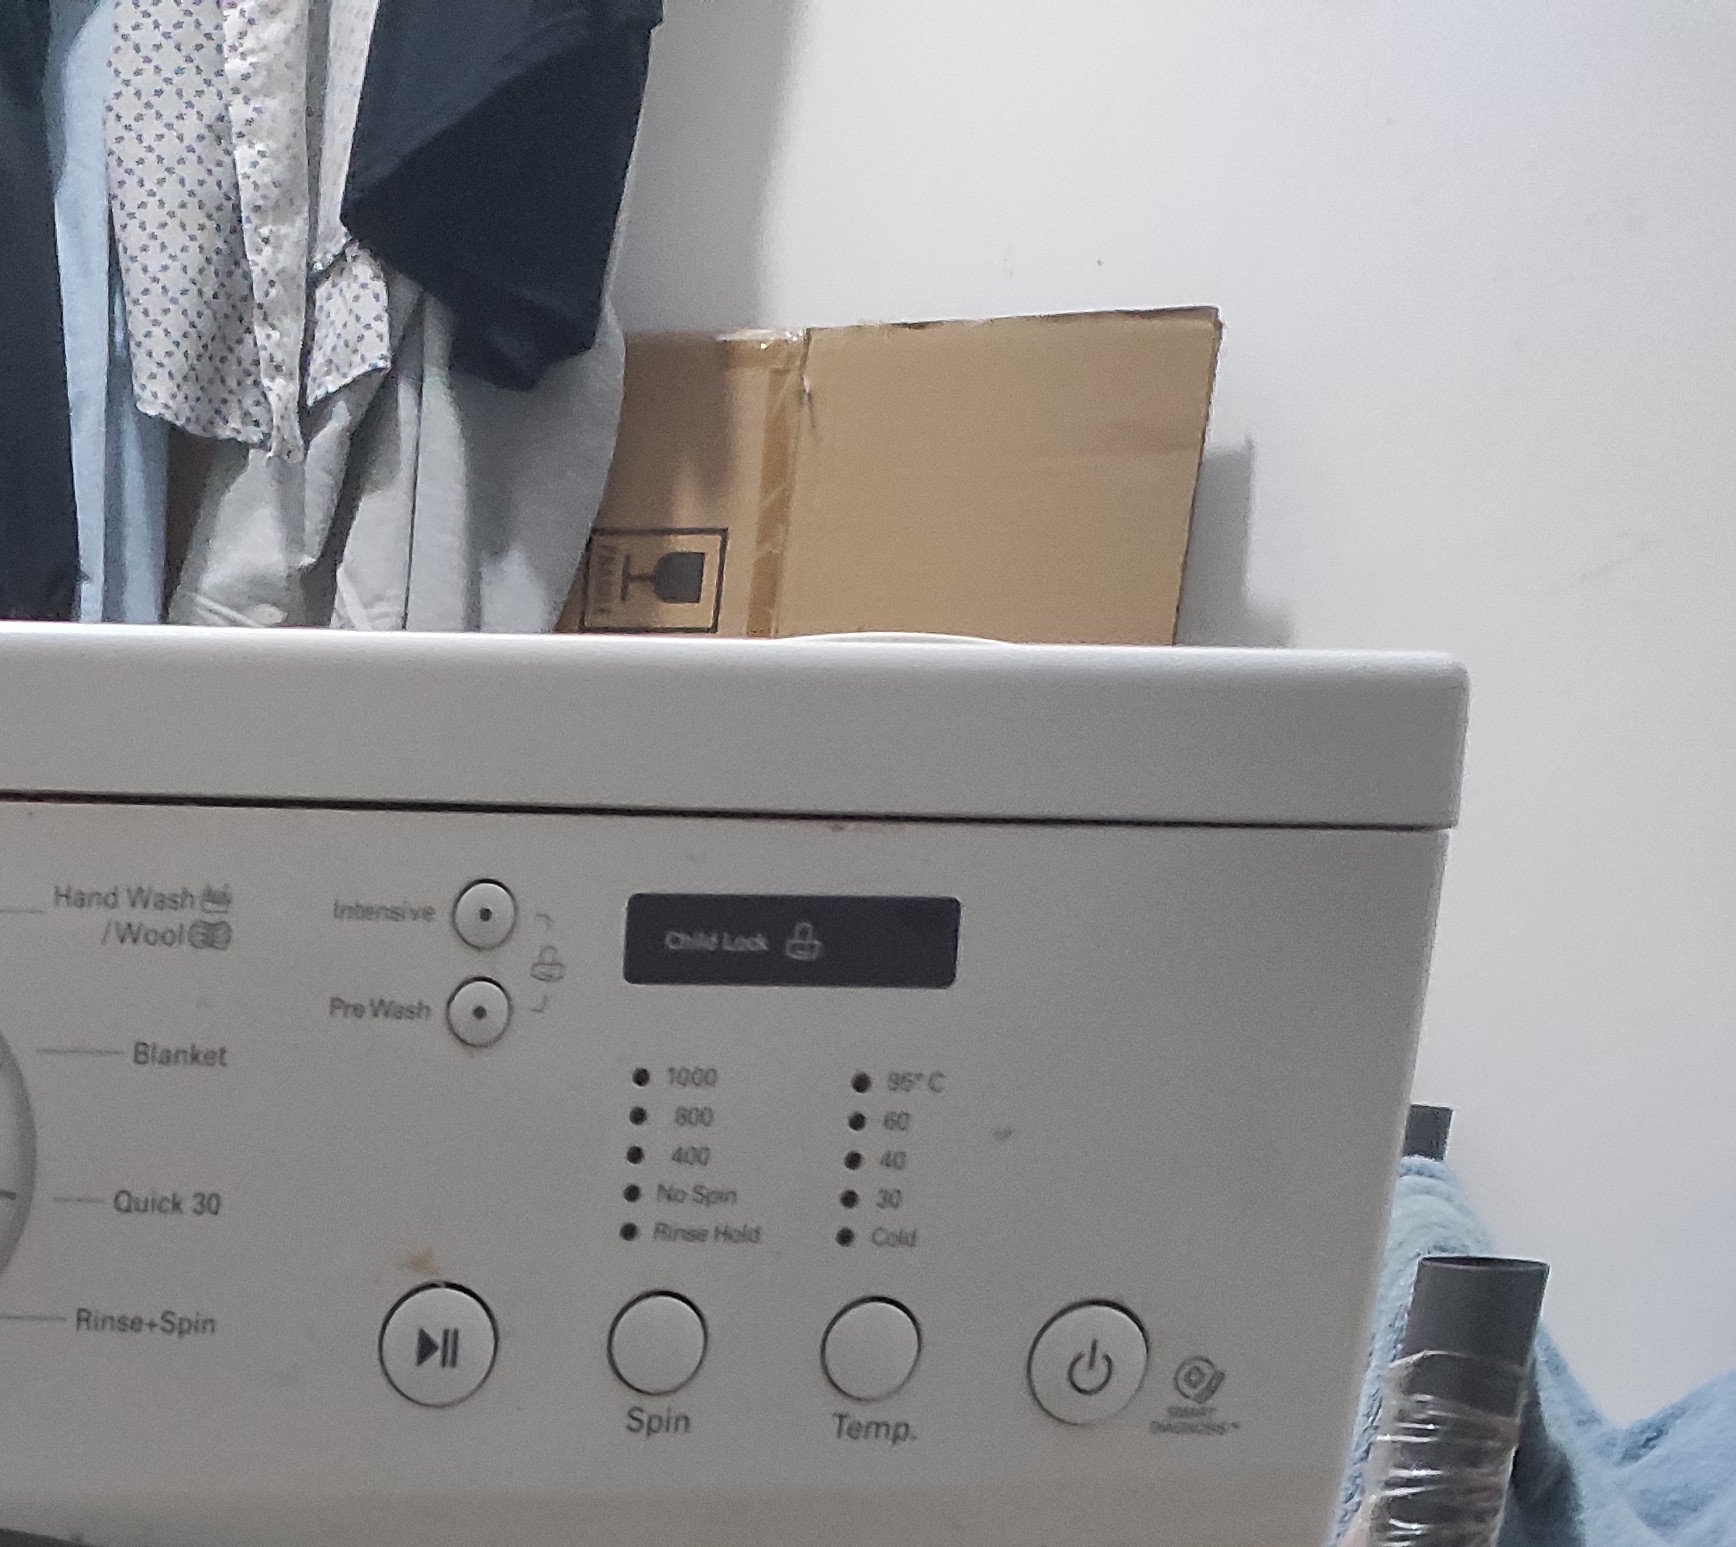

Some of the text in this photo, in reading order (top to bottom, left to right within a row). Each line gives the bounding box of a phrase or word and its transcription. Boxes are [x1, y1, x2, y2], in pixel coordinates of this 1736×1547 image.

[54, 884, 196, 911] Hand Wash
[332, 900, 437, 922] Intensive
[101, 920, 185, 947] /Wool
[665, 929, 770, 952] Child Lock
[329, 996, 433, 1021] Pre Wash
[133, 1041, 228, 1067] Blanket
[667, 1066, 718, 1088] 1000
[675, 1105, 714, 1127] 800
[671, 1145, 712, 1167] 400
[879, 1150, 907, 1171] 40
[114, 1189, 222, 1216] Quick 30
[656, 1184, 738, 1207] No Spin
[875, 1187, 902, 1210] 30
[653, 1221, 762, 1244] Rinse Hold
[871, 1226, 917, 1248] Cold
[75, 1307, 216, 1340] Rinse+Spin
[625, 1405, 691, 1439] Spin
[832, 1410, 918, 1446] Temp.
